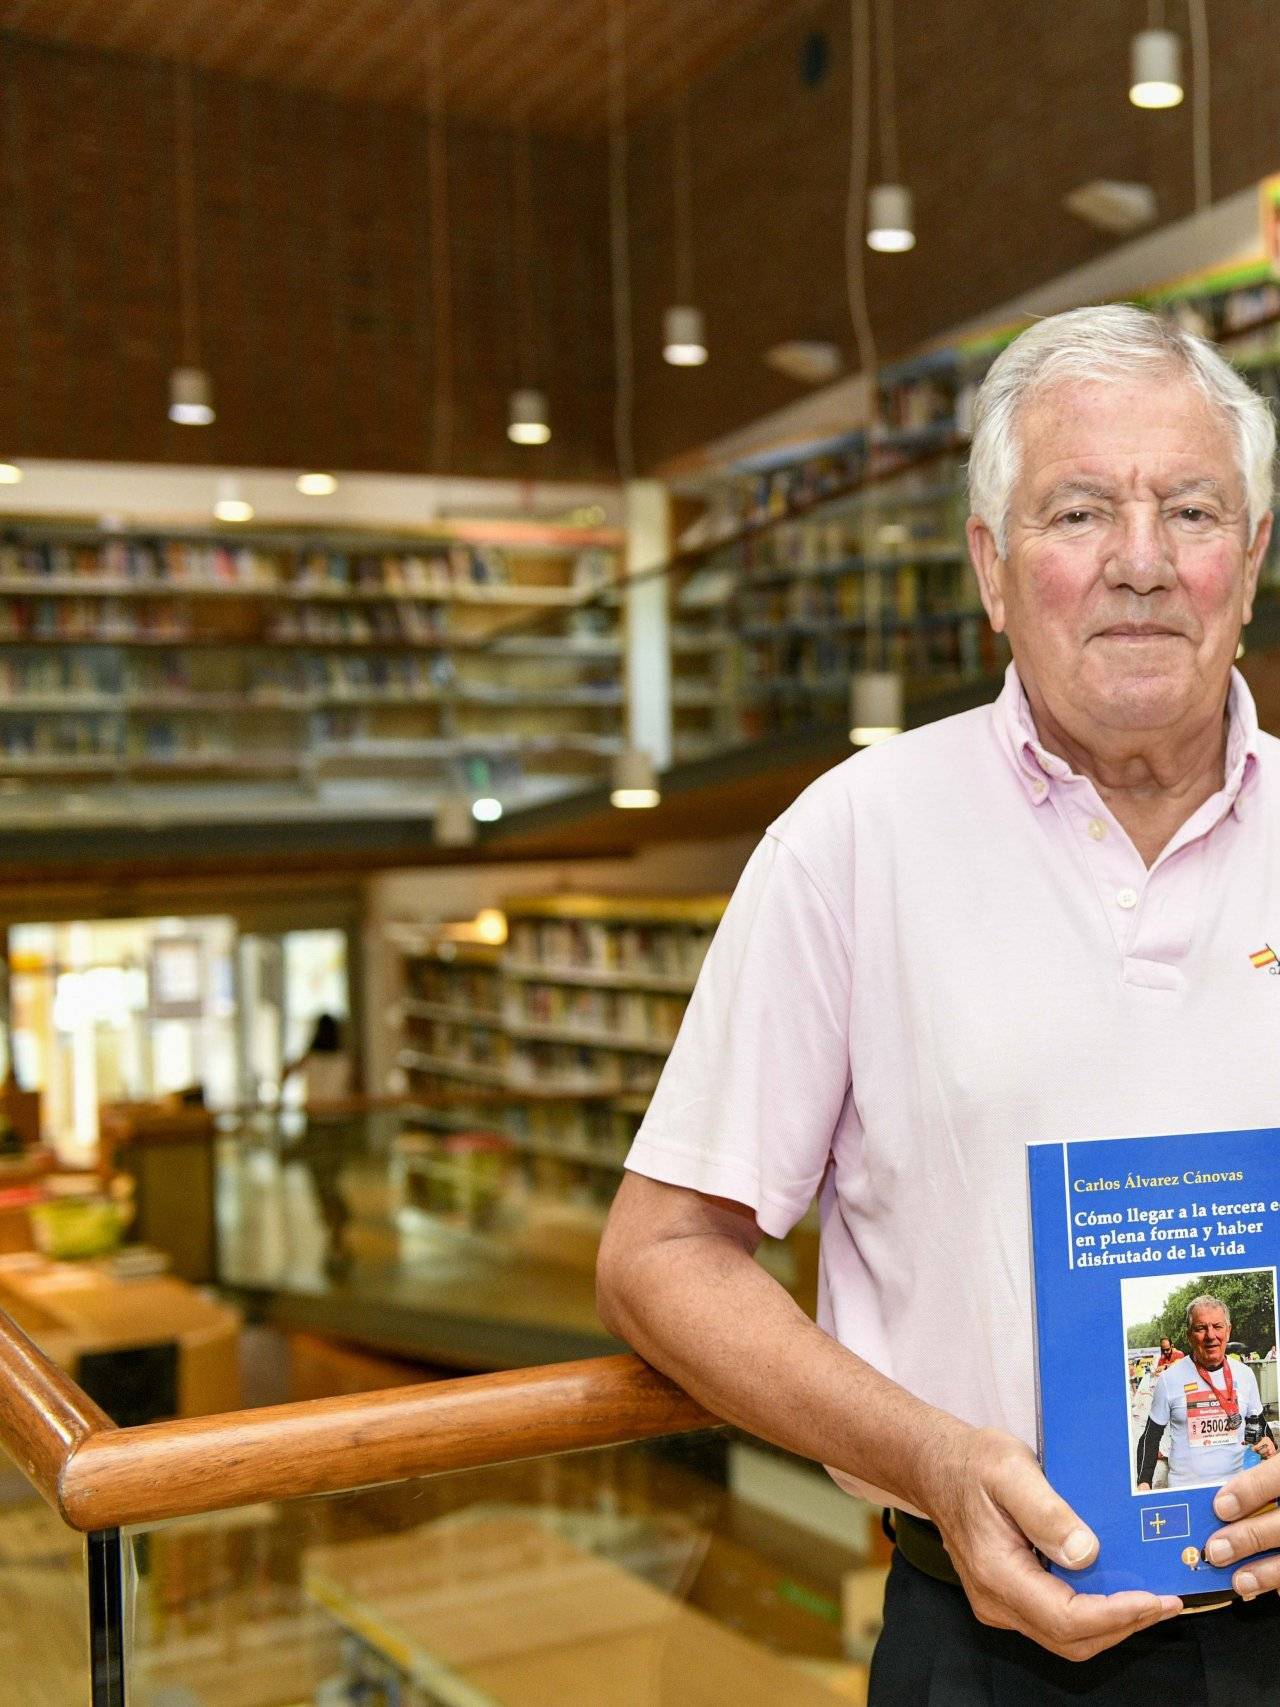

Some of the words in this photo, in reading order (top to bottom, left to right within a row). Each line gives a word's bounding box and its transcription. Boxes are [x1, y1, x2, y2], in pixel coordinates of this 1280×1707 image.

[1073, 1178, 1121, 1193] Carlos
[1124, 1172, 1180, 1189] Álvarez
[1183, 1170, 1244, 1185] Cánovas
[1074, 1210, 1123, 1227] Cómo
[1126, 1207, 1175, 1225] llegar
[1178, 1207, 1188, 1219] a
[1191, 1202, 1208, 1218] la
[1211, 1201, 1266, 1216] tercera
[1075, 1235, 1096, 1248] en
[1099, 1229, 1146, 1250] plena
[1150, 1226, 1199, 1241] forma
[1202, 1226, 1213, 1242] y
[1216, 1220, 1264, 1236] haber
[1076, 1247, 1162, 1268] disfrutado
[1166, 1245, 1187, 1261] de
[1190, 1243, 1206, 1258] la
[1209, 1240, 1246, 1257] vida
